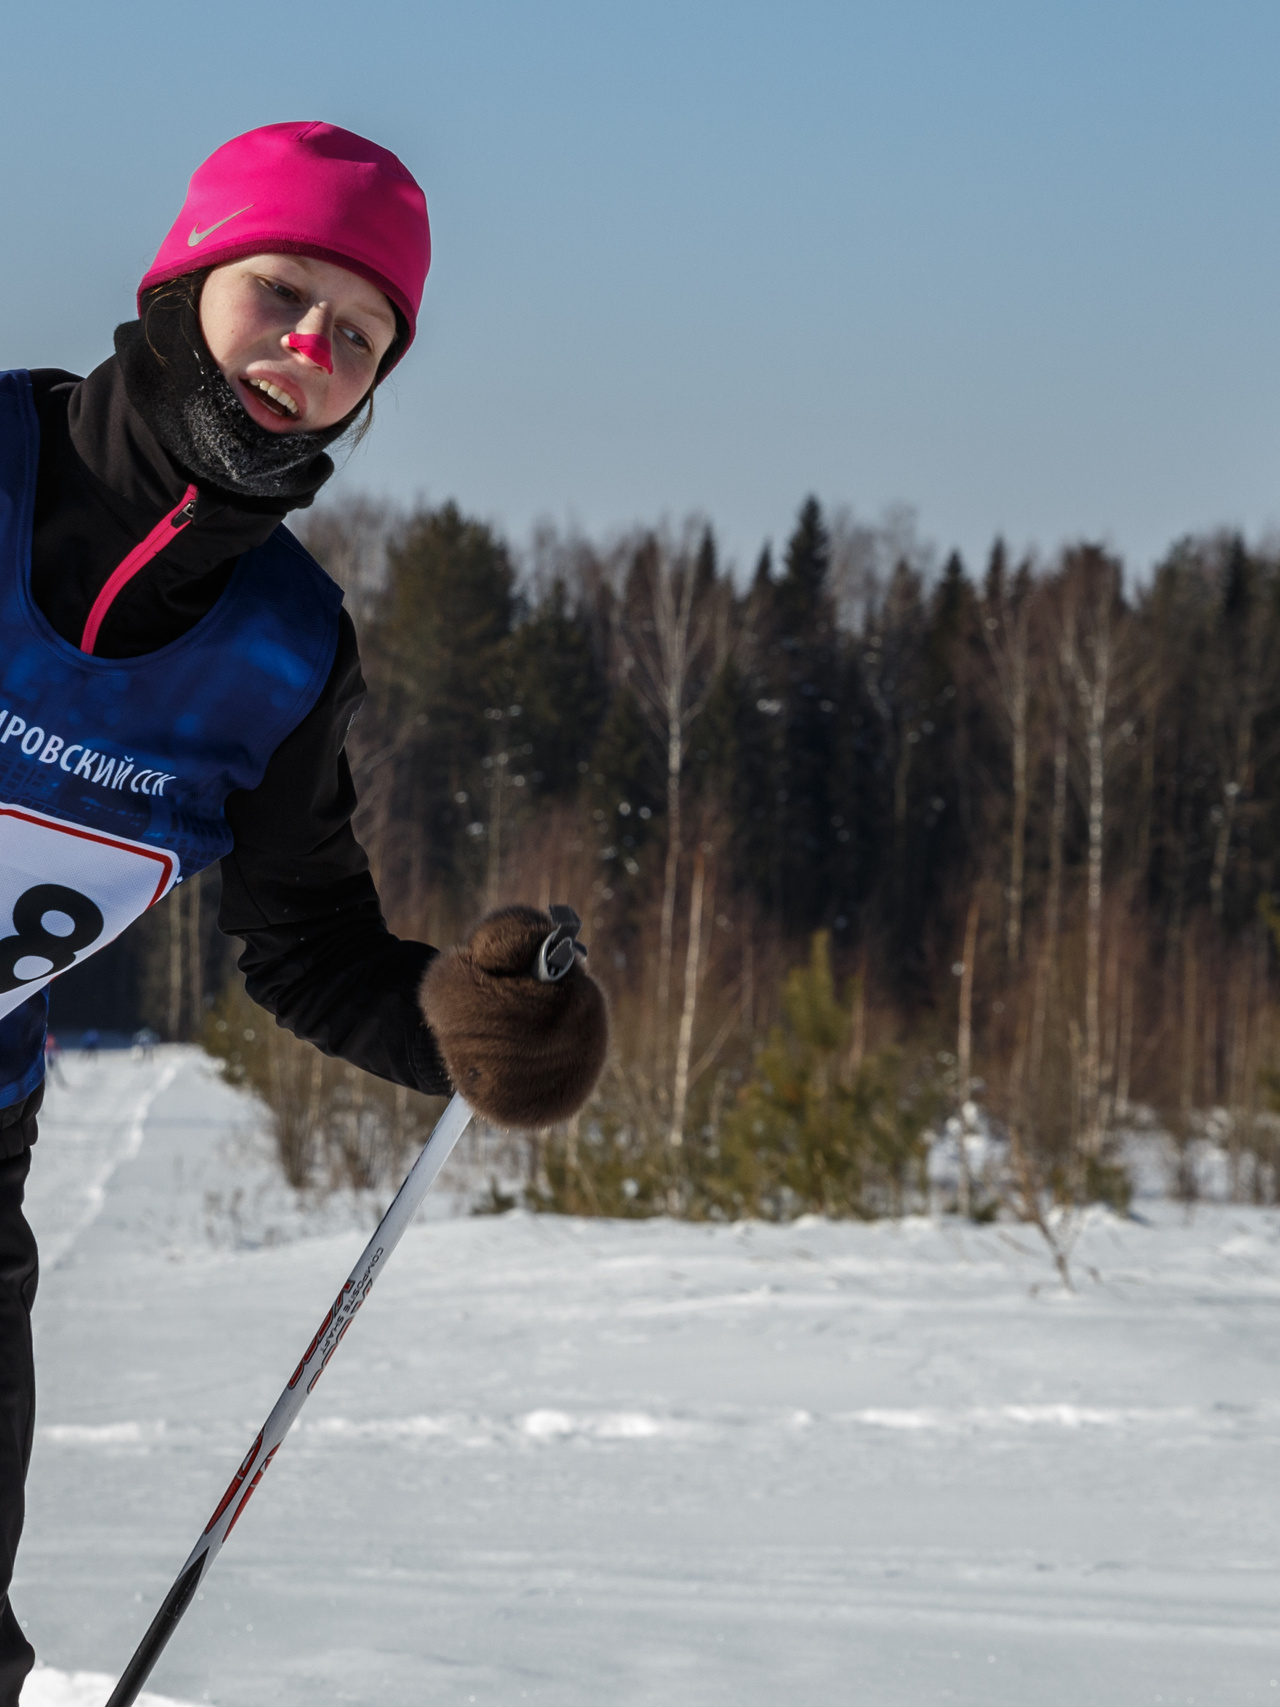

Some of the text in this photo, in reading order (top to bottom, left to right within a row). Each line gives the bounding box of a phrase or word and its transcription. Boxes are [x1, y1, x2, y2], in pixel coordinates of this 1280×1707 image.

[130, 768, 177, 797] ССК
[342, 1246, 384, 1313] COMPOSITE
[321, 1314, 345, 1355] SHAFT
